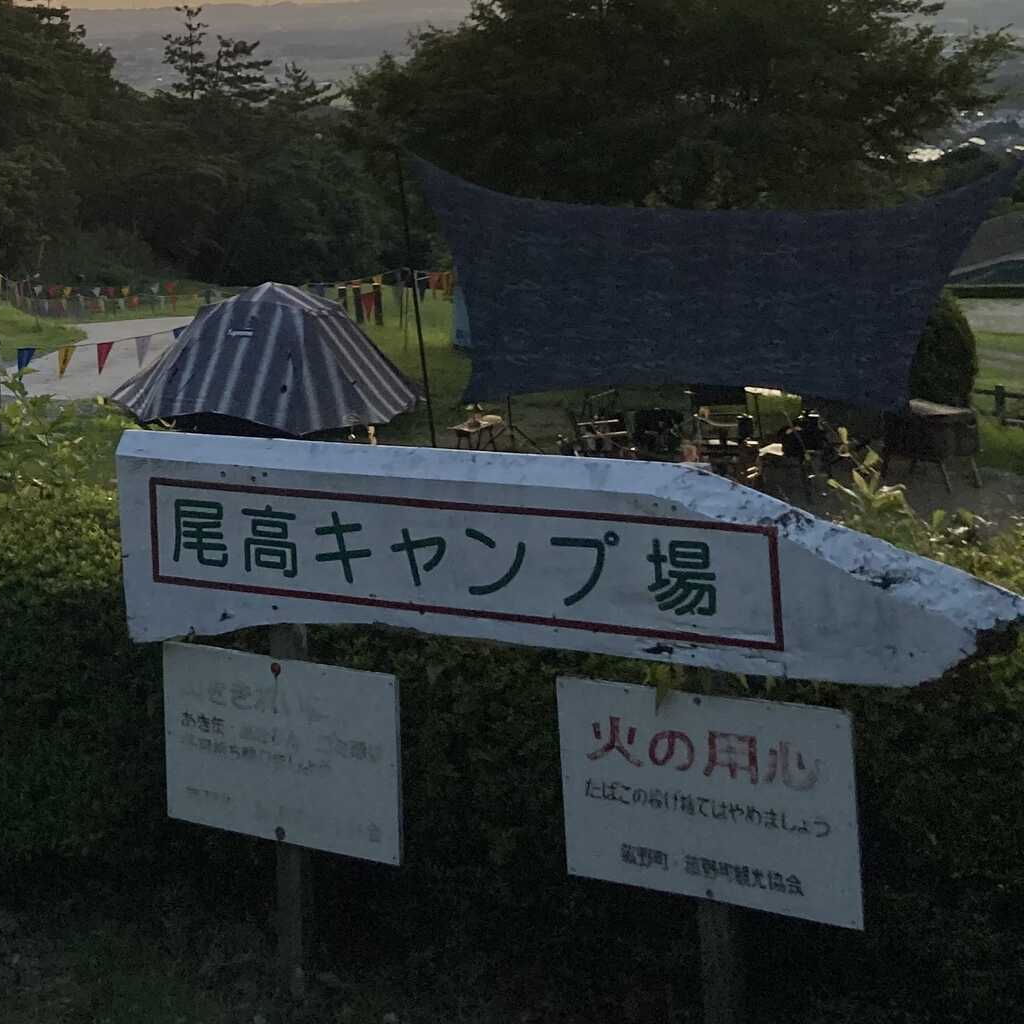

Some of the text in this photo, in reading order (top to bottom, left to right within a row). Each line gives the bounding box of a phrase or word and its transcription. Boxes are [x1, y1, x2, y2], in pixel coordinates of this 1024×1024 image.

[172, 497, 718, 617] 尾高キャンプ場
[585, 715, 825, 792] 火の用心
